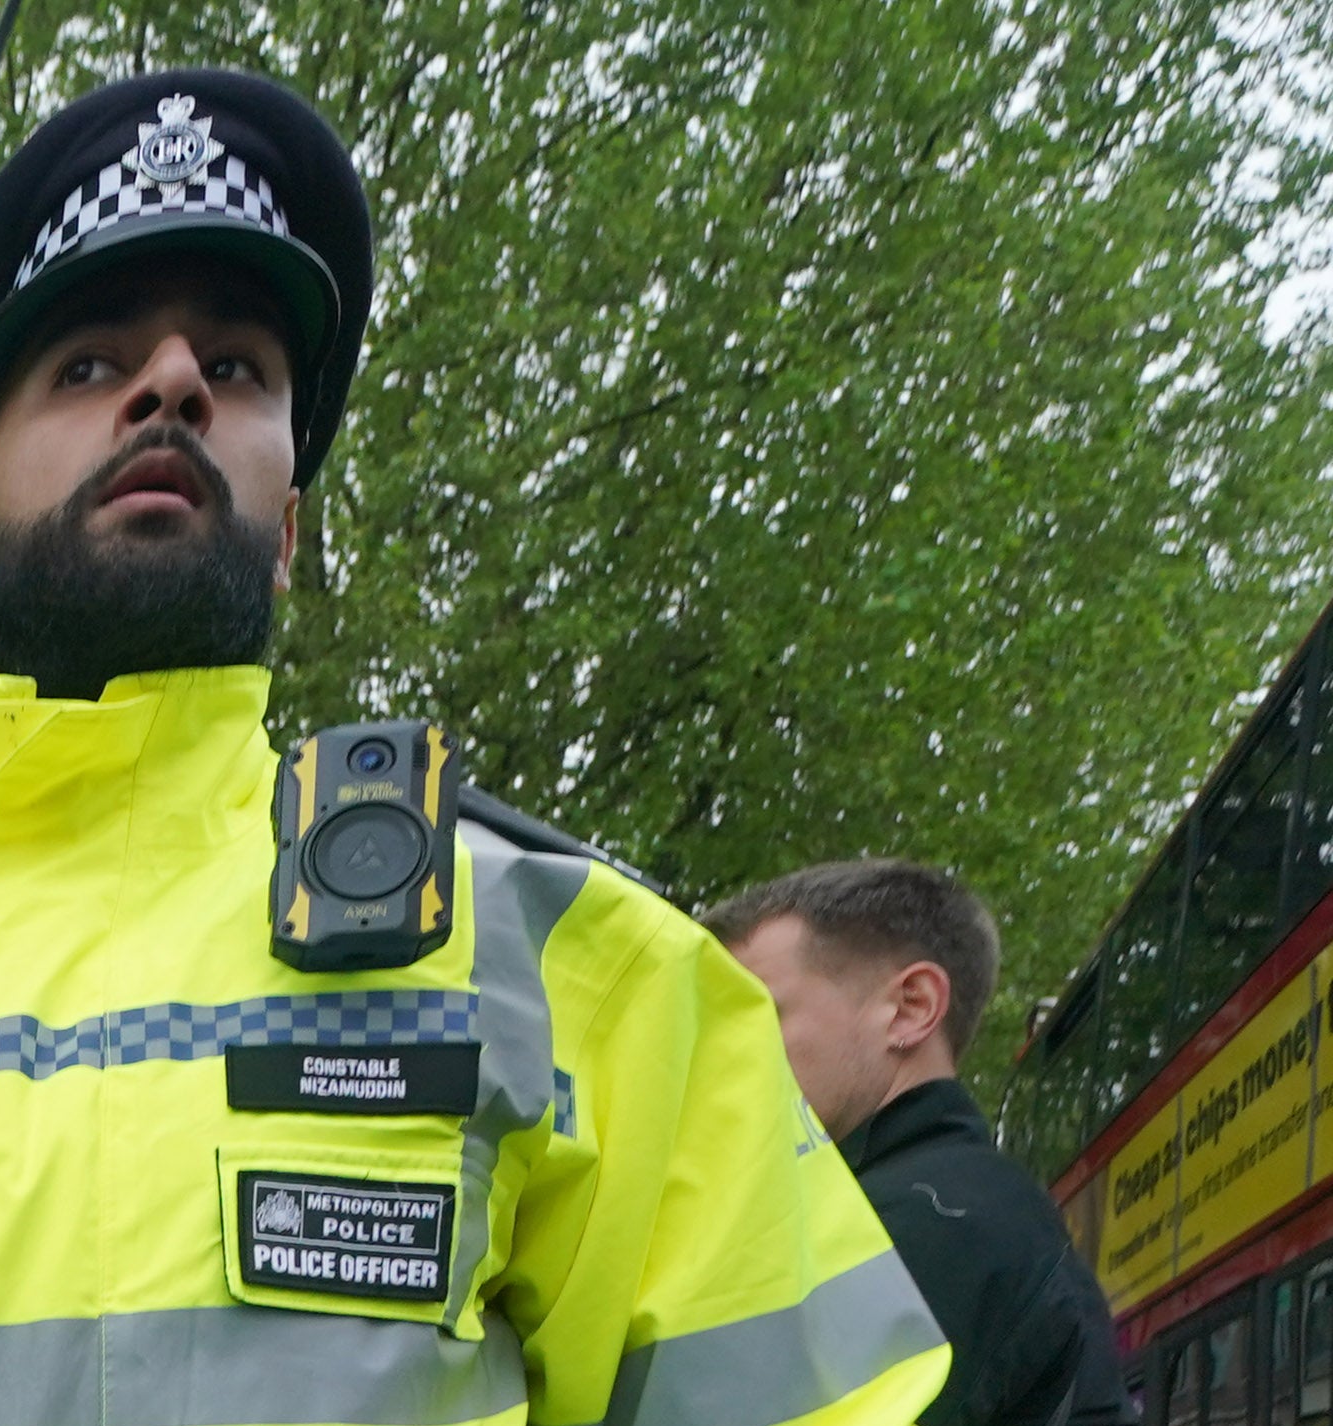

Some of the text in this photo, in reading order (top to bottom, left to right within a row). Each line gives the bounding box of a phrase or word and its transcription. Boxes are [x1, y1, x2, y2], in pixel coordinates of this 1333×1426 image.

[303, 1056, 400, 1077] CONSTABLE
[300, 1076, 406, 1099] NIZAMUDDIN
[1114, 1151, 1161, 1218] Cheap
[1186, 1079, 1239, 1158] chips
[1242, 999, 1323, 1111] money
[307, 1193, 436, 1220] METROPOLITAN
[322, 1217, 416, 1244] POLICE
[253, 1244, 439, 1289] POLICE OFFICER
